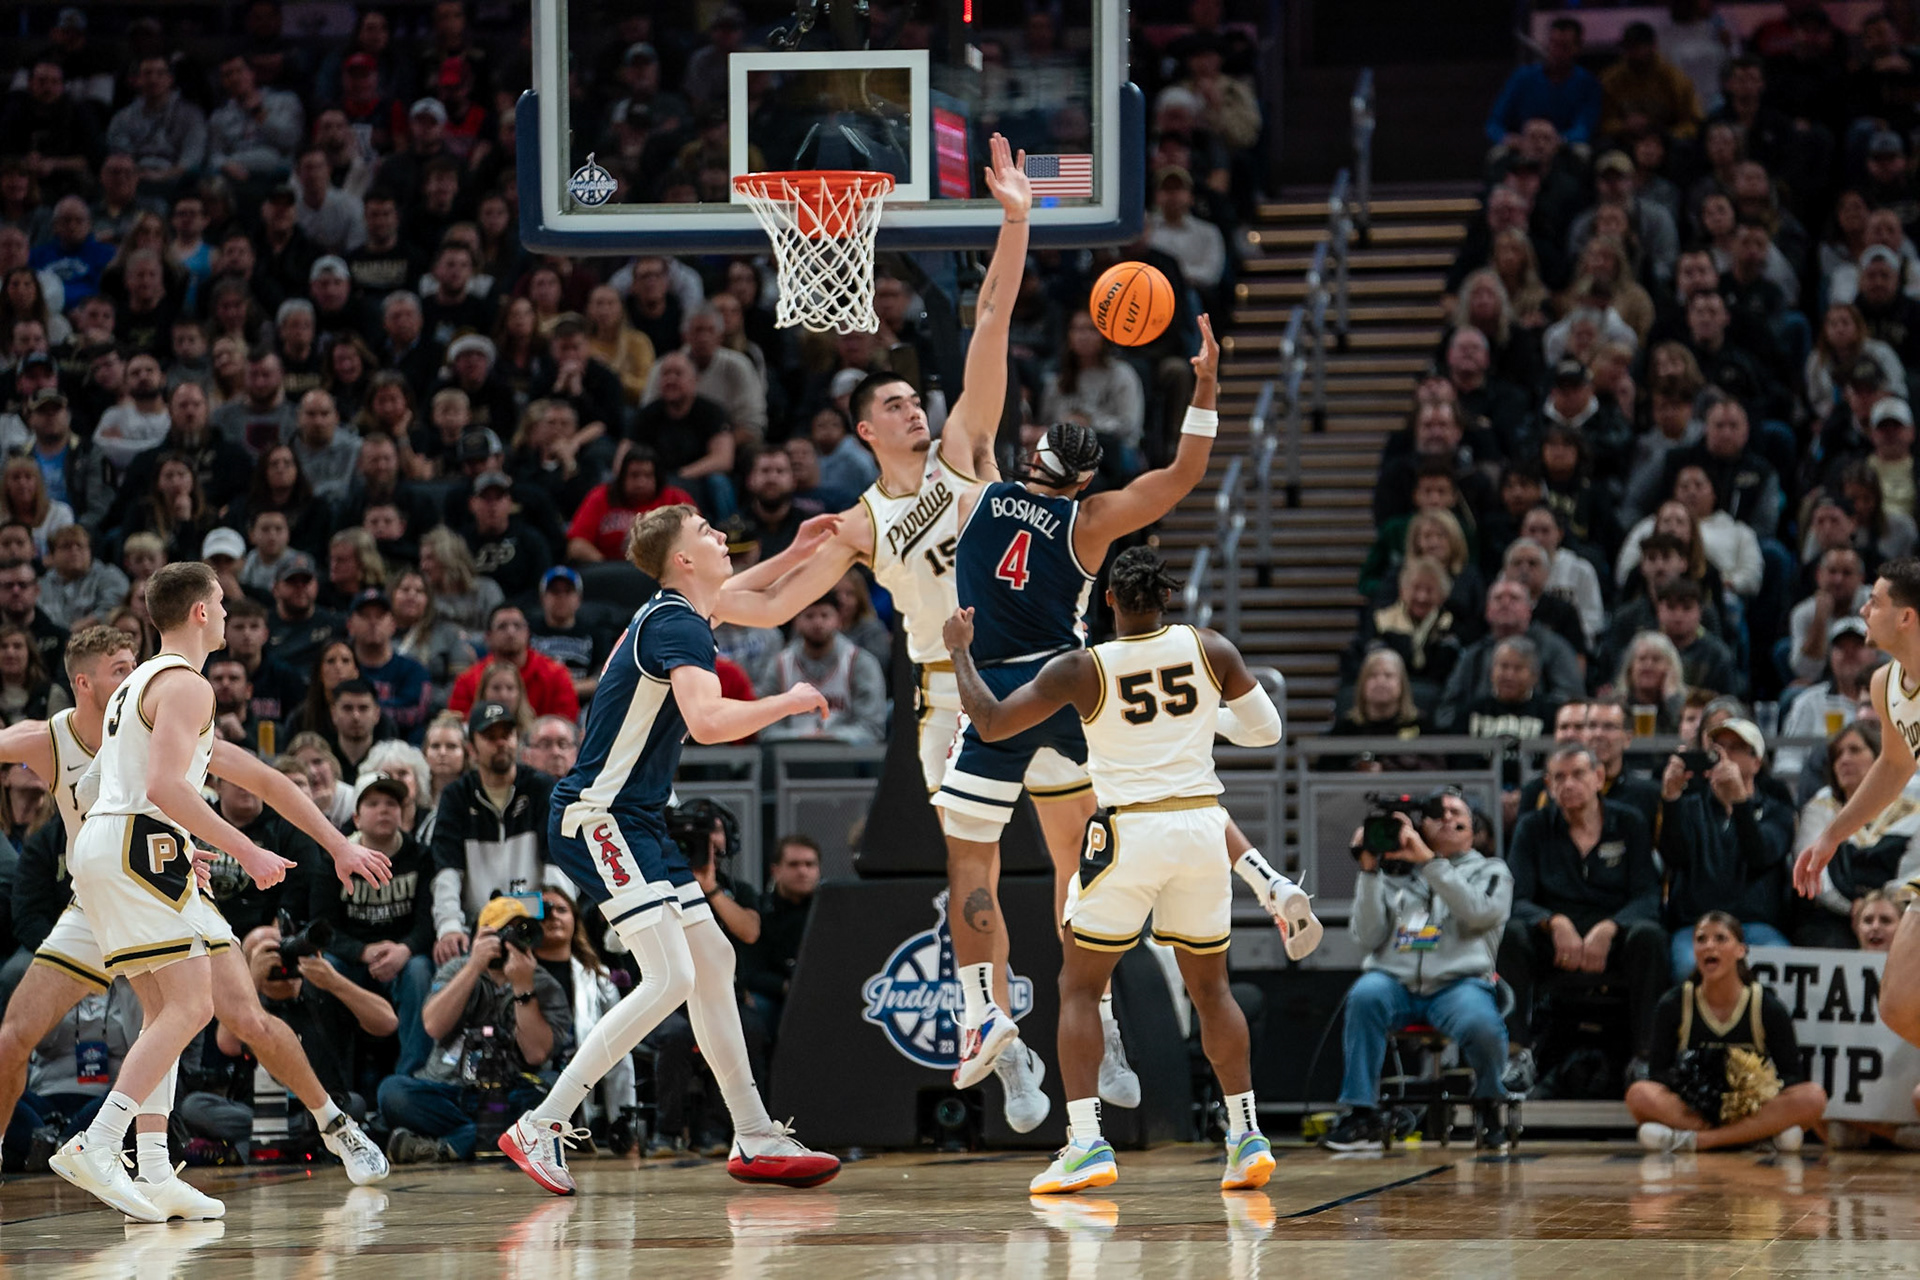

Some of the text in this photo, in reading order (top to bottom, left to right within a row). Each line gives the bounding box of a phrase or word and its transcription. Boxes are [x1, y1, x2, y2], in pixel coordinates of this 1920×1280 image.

[887, 481, 953, 560] Purdue
[991, 497, 1060, 540] BOSWELL
[995, 529, 1031, 591] 4
[108, 684, 131, 738] 3
[1115, 661, 1199, 726] 55
[146, 832, 178, 874] P
[593, 822, 631, 888] CATS
[1085, 820, 1107, 860] P
